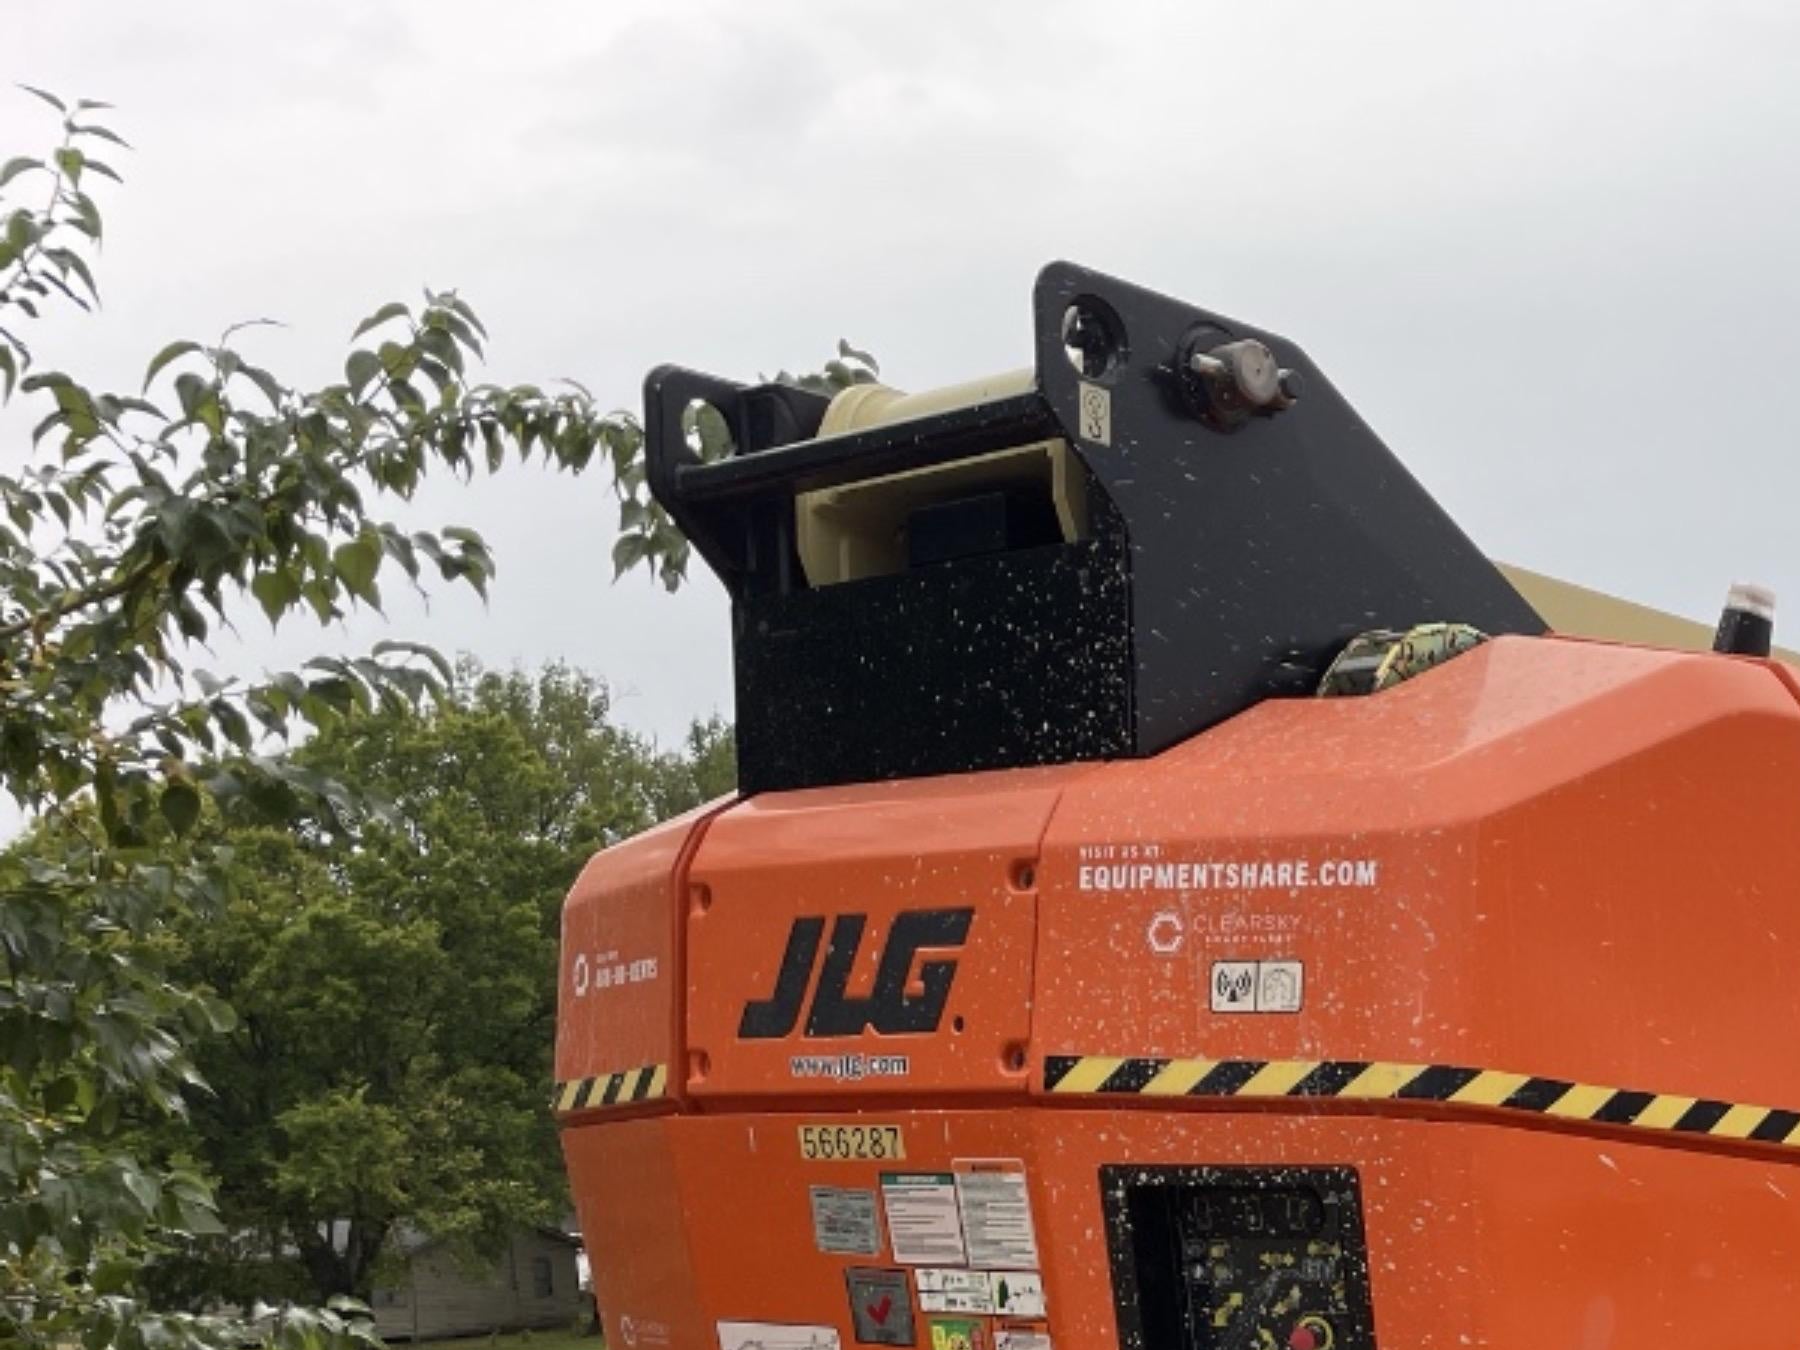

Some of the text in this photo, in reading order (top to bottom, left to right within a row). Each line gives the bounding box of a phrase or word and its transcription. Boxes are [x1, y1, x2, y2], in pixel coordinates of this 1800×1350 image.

[1078, 860, 1377, 890] EQUIPMENTSHARE.COM
[1193, 914, 1302, 932] CLEARSKY
[737, 905, 976, 1039] JLG
[791, 1056, 909, 1081] www.jlg.com
[802, 1127, 899, 1160] 566287
